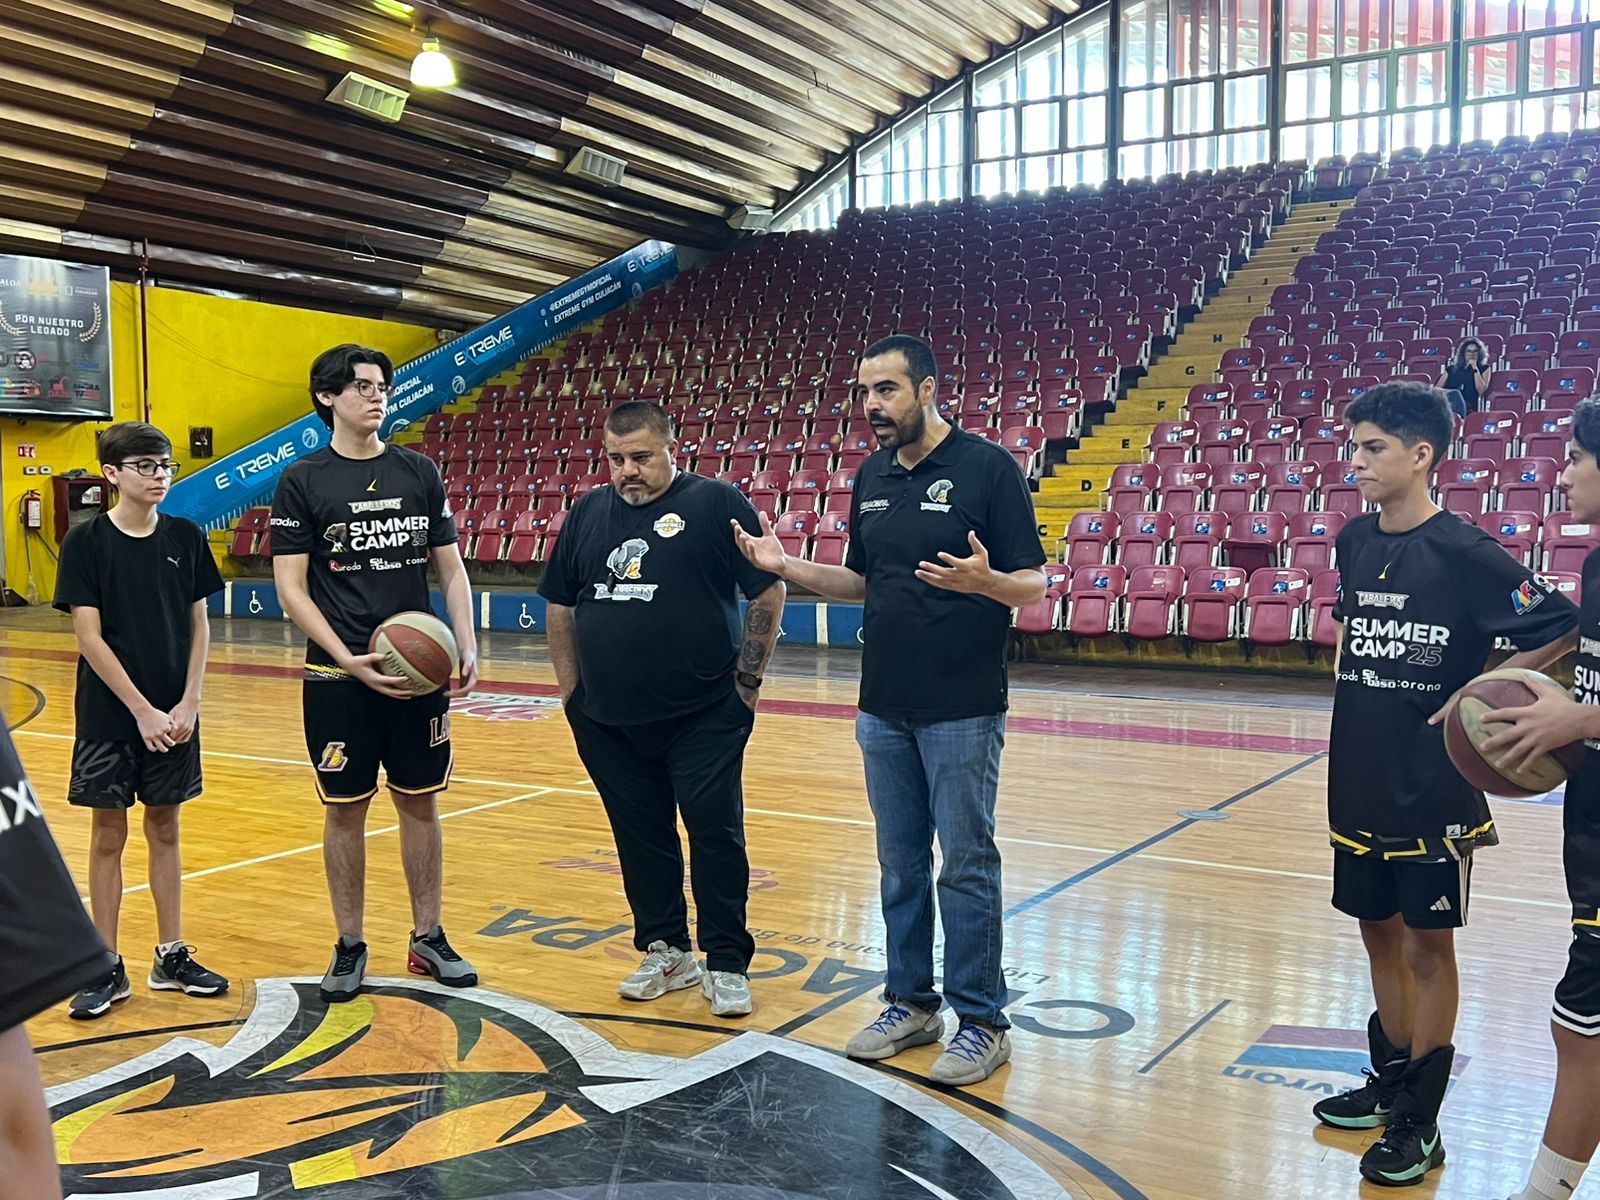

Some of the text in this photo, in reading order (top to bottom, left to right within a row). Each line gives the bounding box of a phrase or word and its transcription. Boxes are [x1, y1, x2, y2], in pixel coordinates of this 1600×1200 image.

[0, 279, 21, 287] ALOA
[553, 304, 581, 324] EXTREME
[581, 296, 595, 309] GYM
[15, 314, 84, 328] POR NUESTRO
[30, 325, 70, 337] LEGADO
[1213, 334, 1223, 343] H
[454, 325, 514, 367] EXTREME
[1185, 366, 1195, 376] G
[399, 383, 434, 409] CULIACÁN
[1157, 401, 1166, 411] F
[1121, 439, 1130, 449] E
[215, 441, 296, 490] EXTREME
[1081, 479, 1092, 492] D
[350, 516, 430, 537] SUMMER
[1038, 525, 1048, 537] C
[350, 531, 428, 551] CAMP 25
[1351, 617, 1450, 646] SUMMER
[1350, 638, 1442, 667] CAMP 25
[1002, 966, 1050, 985] Lig
